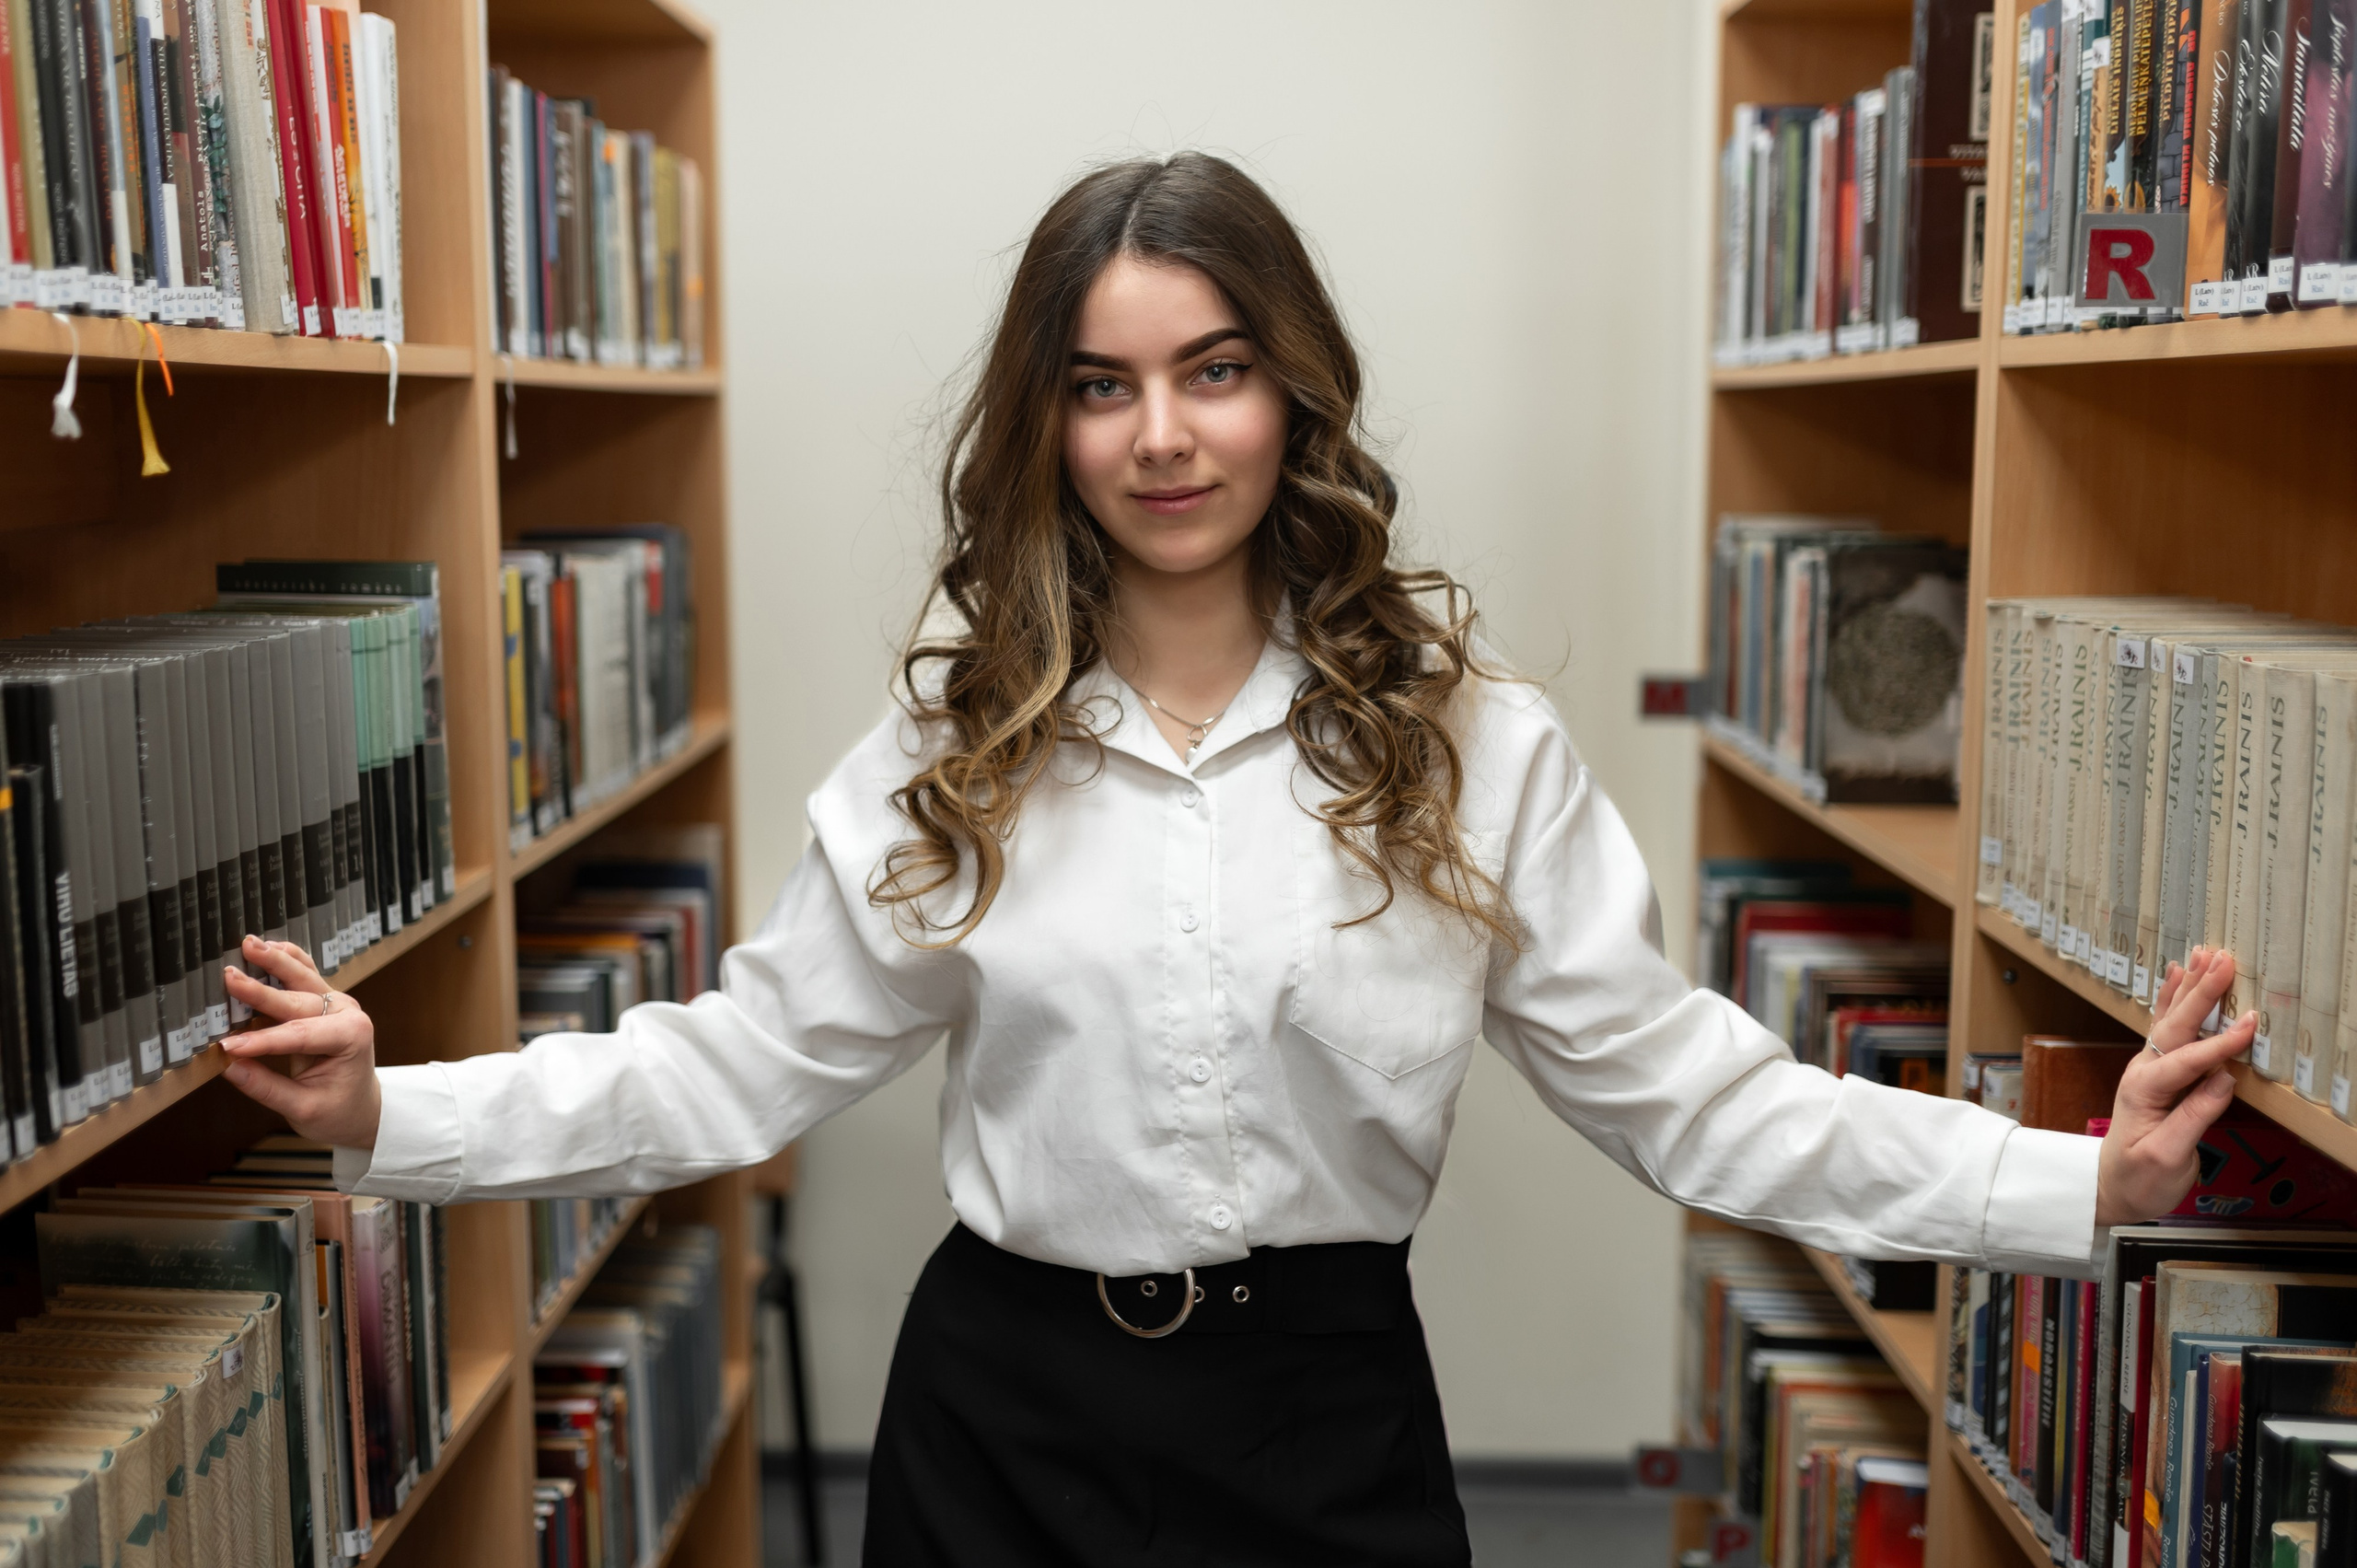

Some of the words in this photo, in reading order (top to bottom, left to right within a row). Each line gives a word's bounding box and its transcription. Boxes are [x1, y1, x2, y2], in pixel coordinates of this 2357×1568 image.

[2109, 78, 2121, 135] LIELAIS
[2211, 49, 2232, 129] Debesis
[2207, 128, 2220, 187] pelnos
[196, 191, 209, 252] Anatols
[2084, 228, 2156, 300] R
[2070, 645, 2088, 749] RAINIS
[2169, 682, 2187, 787] RAINI
[2211, 679, 2230, 800] RAINIS
[2237, 691, 2254, 813] RAINIS
[2269, 696, 2285, 822] RAINIS
[2313, 705, 2328, 837] RAINIS
[2124, 1303, 2132, 1361] GUNDEGA
[2041, 1318, 2055, 1429] NORAKSTĪTIE
[2122, 1363, 2131, 1396] REPŠE
[2166, 1396, 2178, 1457] Gundega
[2206, 1393, 2217, 1439] Gundega
[2236, 1402, 2245, 1458] GUNDEGA
[2165, 1460, 2176, 1503] Repše
[2205, 1439, 2215, 1470] Repše
[2256, 1456, 2264, 1487] Iveta
[2201, 1504, 2214, 1552] STĀSTI
